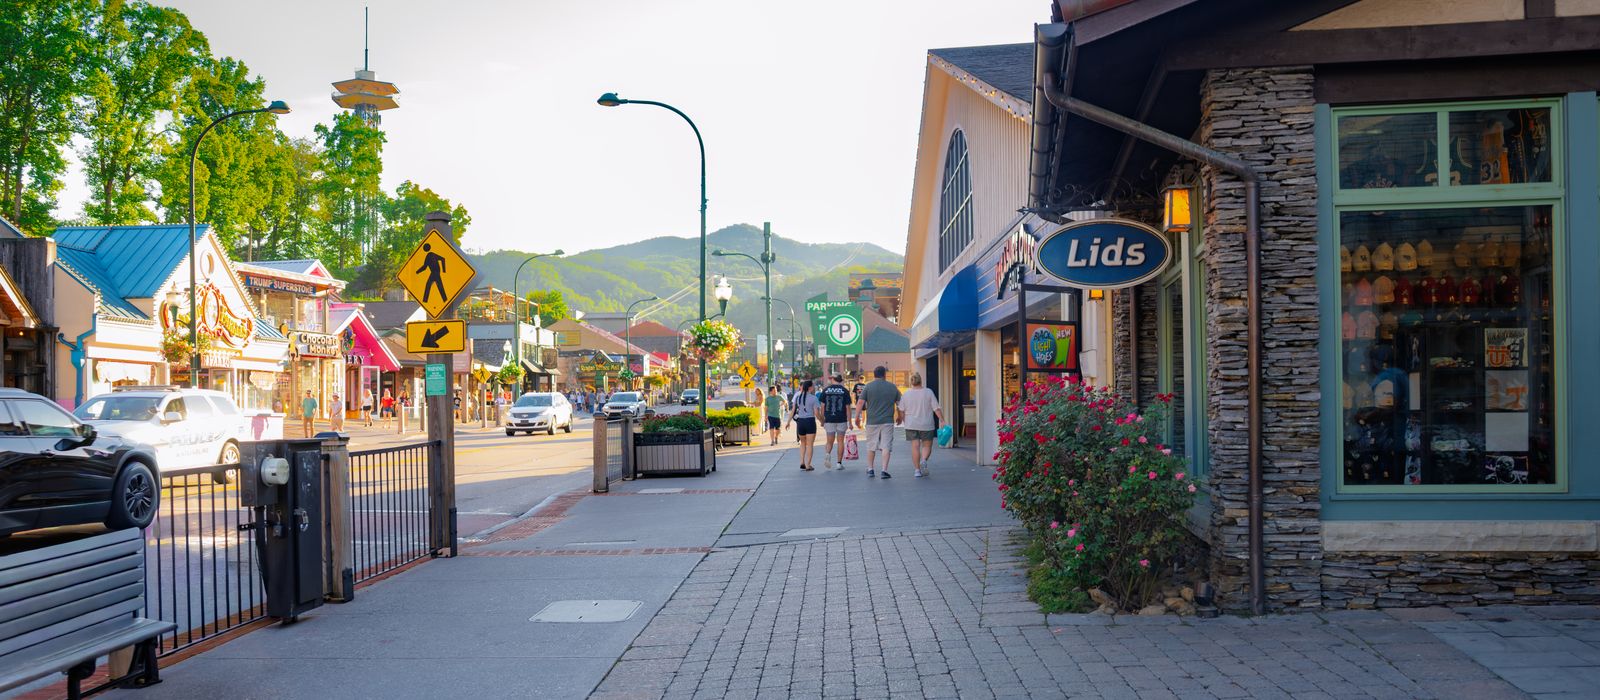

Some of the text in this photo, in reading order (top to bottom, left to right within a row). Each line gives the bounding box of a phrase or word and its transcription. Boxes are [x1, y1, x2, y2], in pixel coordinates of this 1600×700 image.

[1067, 237, 1146, 267] Lids
[249, 277, 314, 294] TRUMP SUPERSTORE
[839, 323, 851, 338] P
[1056, 329, 1072, 339] NEW
[309, 344, 339, 357] Monkey
